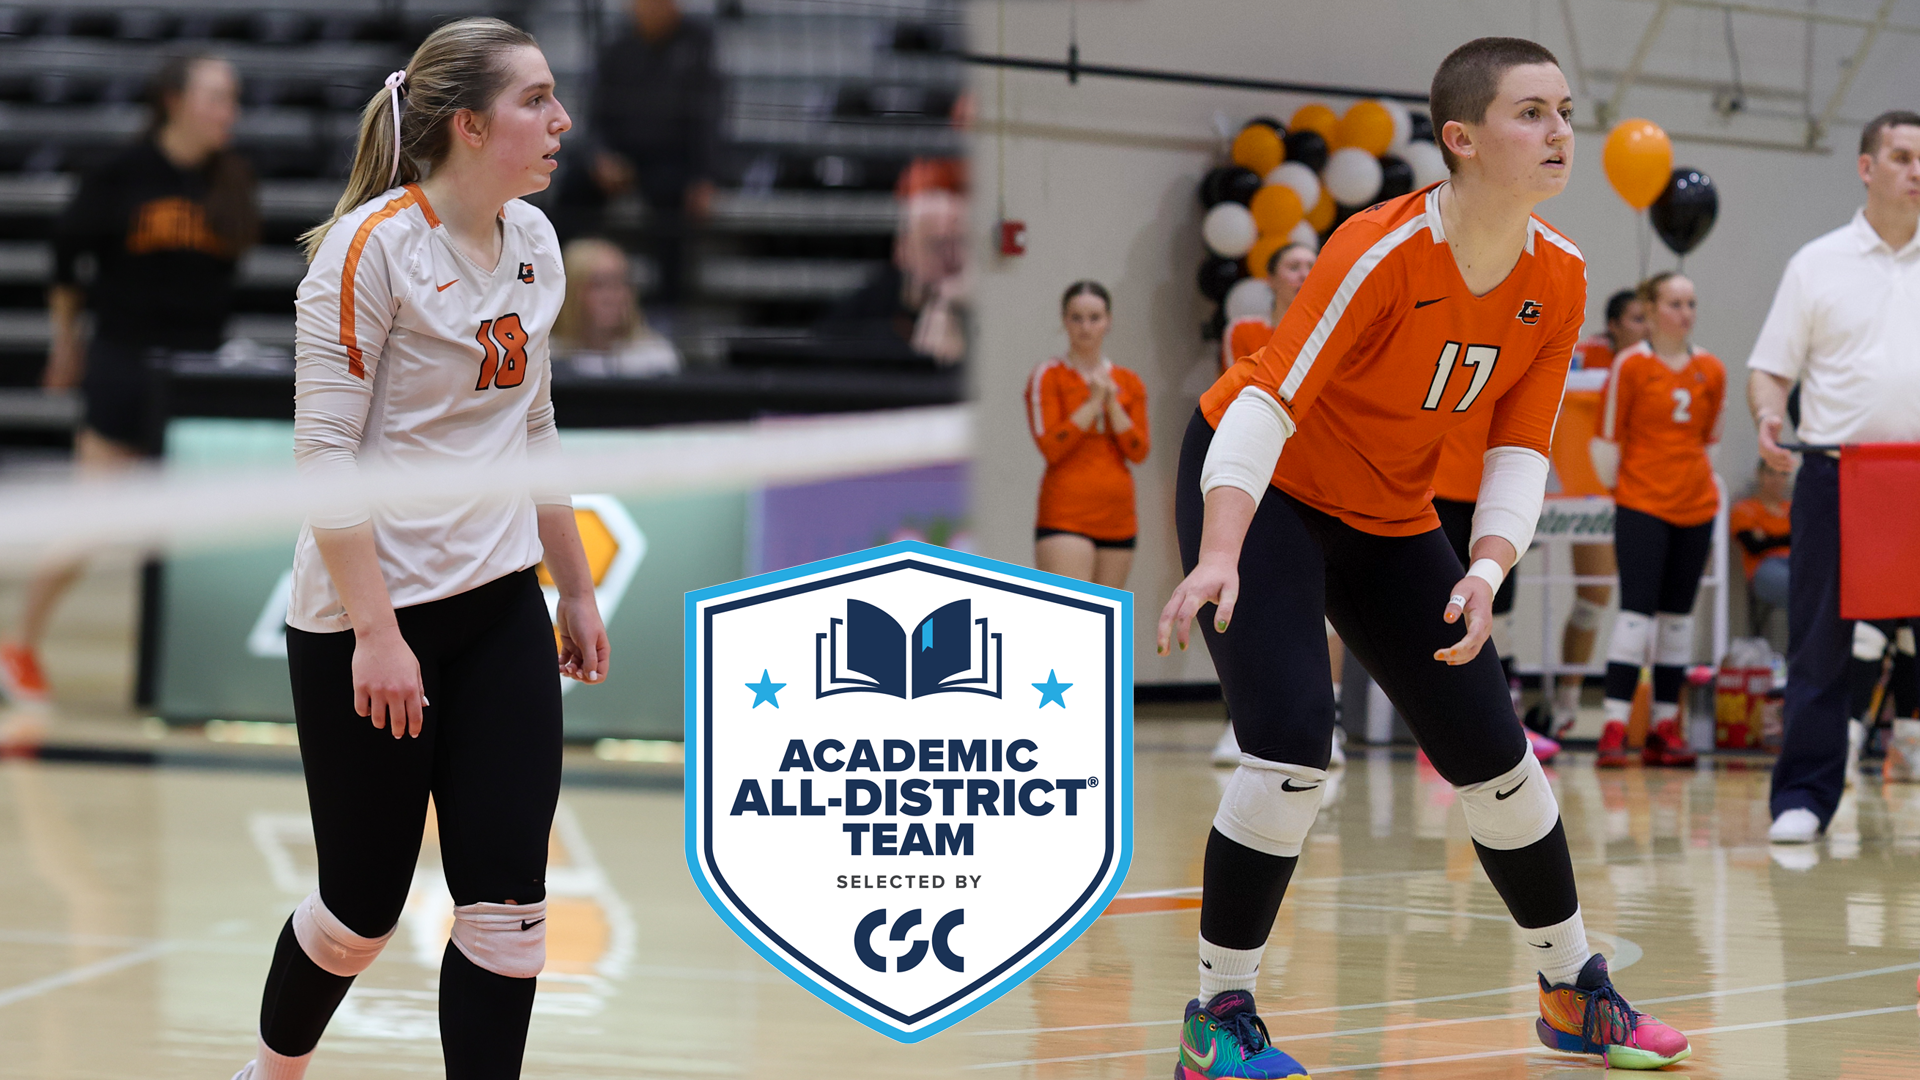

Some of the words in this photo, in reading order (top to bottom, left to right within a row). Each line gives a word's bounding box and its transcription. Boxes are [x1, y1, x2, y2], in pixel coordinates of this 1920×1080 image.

[475, 312, 529, 391] 18
[1421, 340, 1501, 413] 17
[1672, 387, 1692, 424] 2
